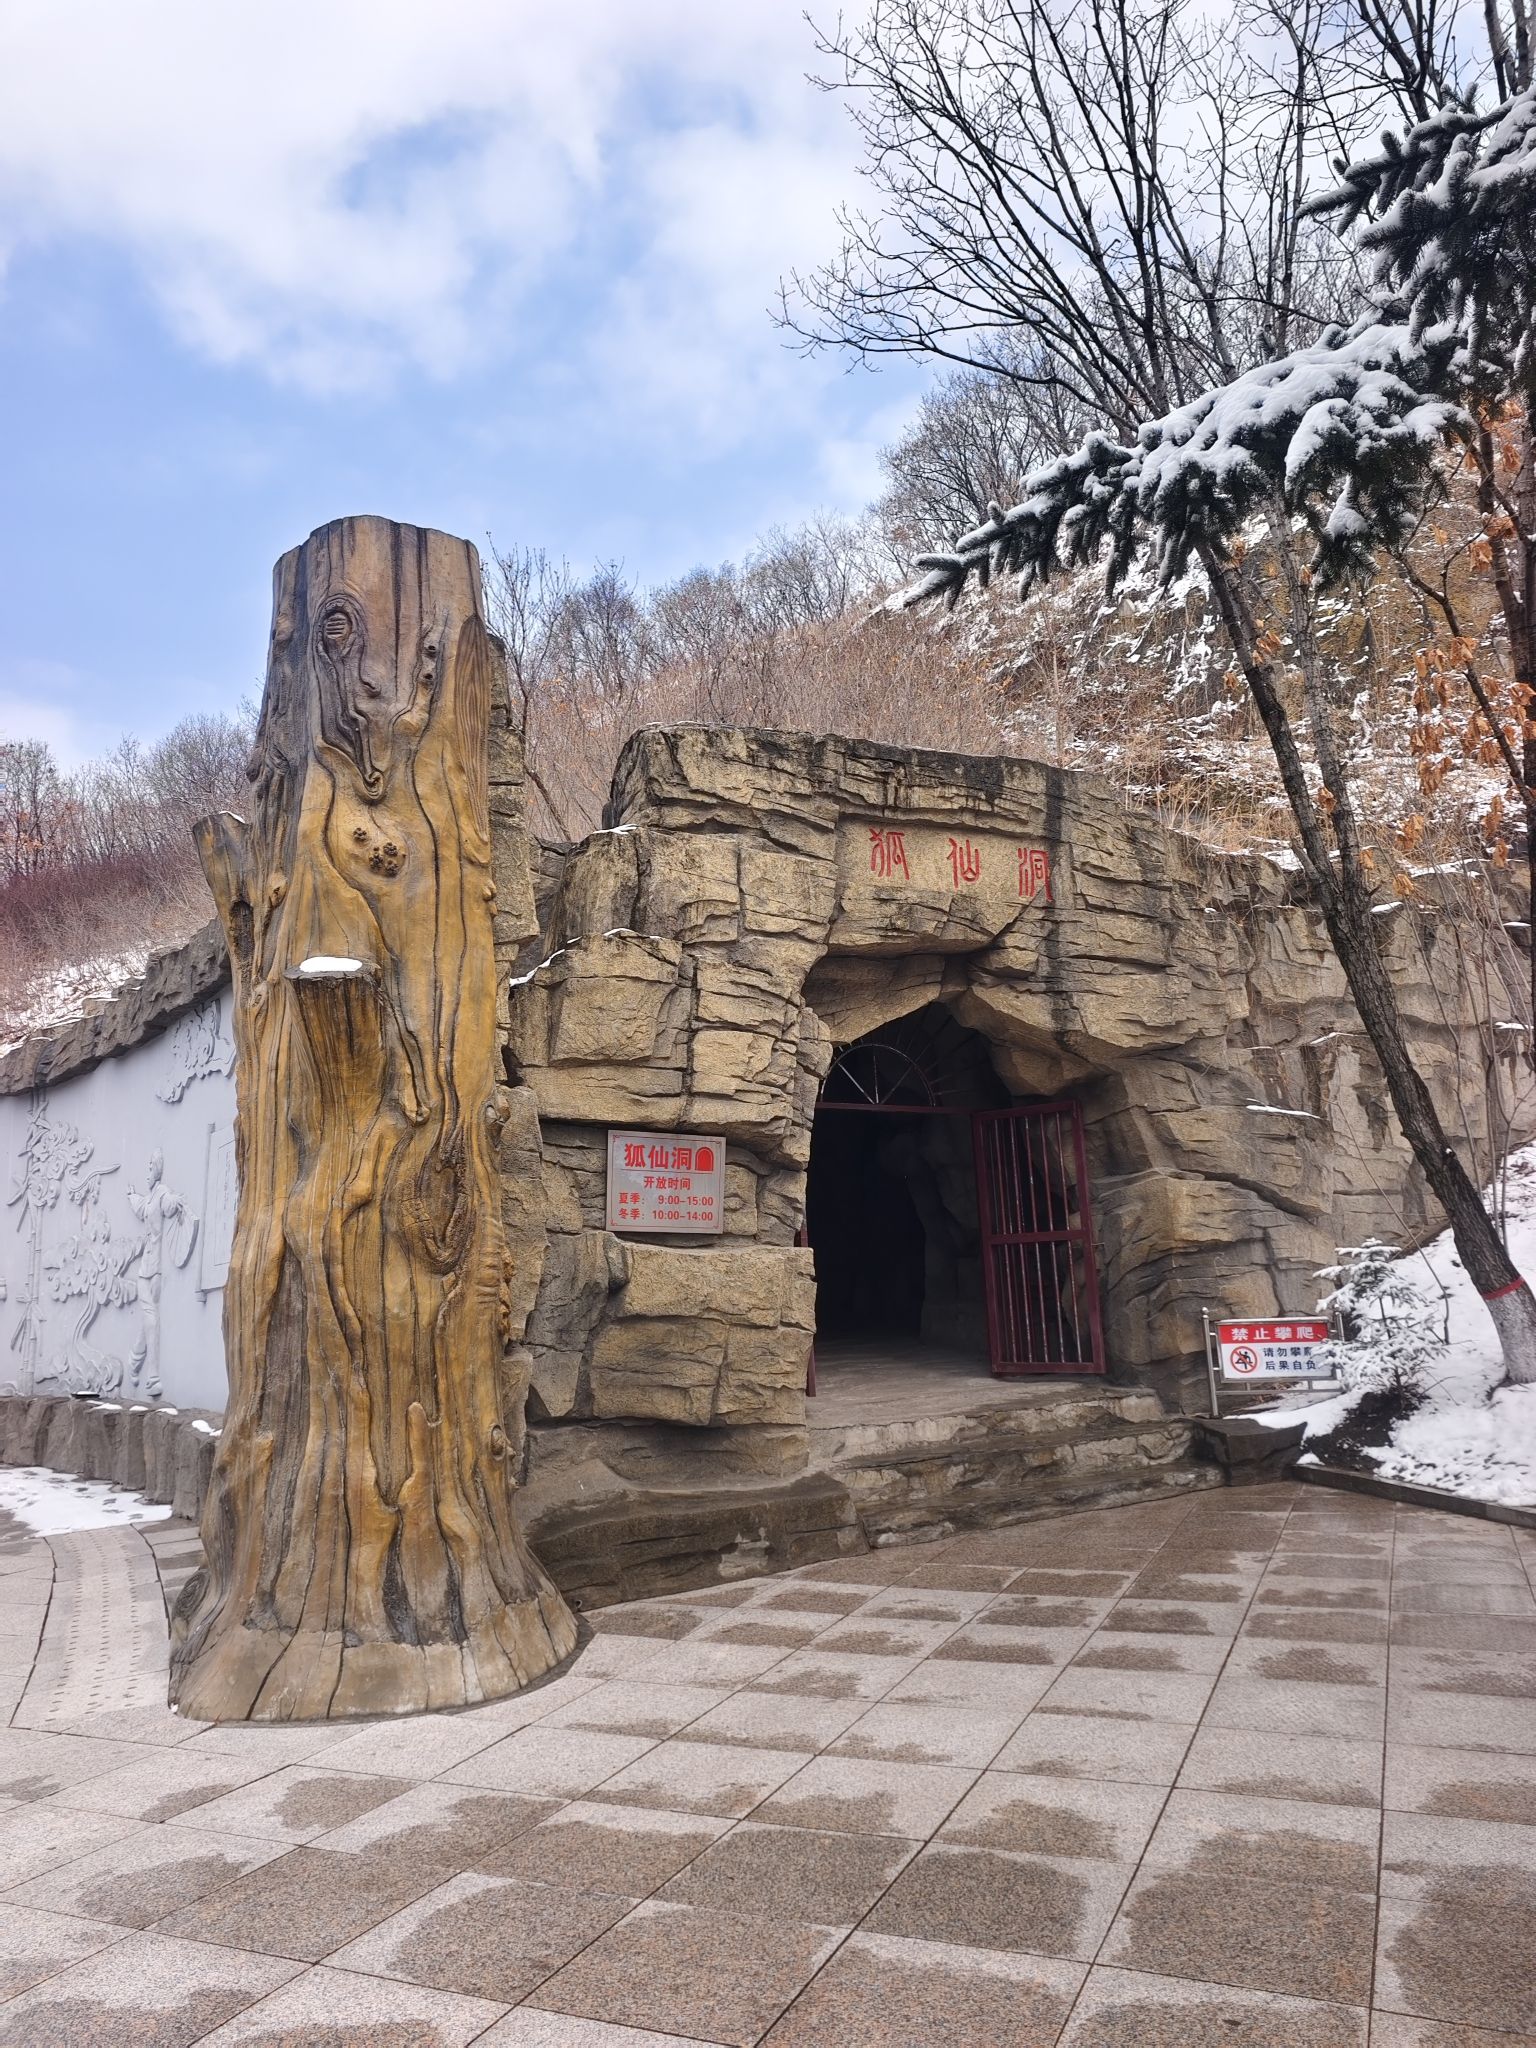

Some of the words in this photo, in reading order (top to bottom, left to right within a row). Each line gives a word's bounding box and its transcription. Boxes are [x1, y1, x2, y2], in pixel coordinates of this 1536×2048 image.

[869, 828, 1053, 901] 狐仙洞
[624, 1143, 692, 1170] 狐仙洞
[644, 1176, 691, 1190] 开放时间
[1231, 1326, 1314, 1341] 禁止攀爬
[1265, 1360, 1316, 1370] 后果自负
